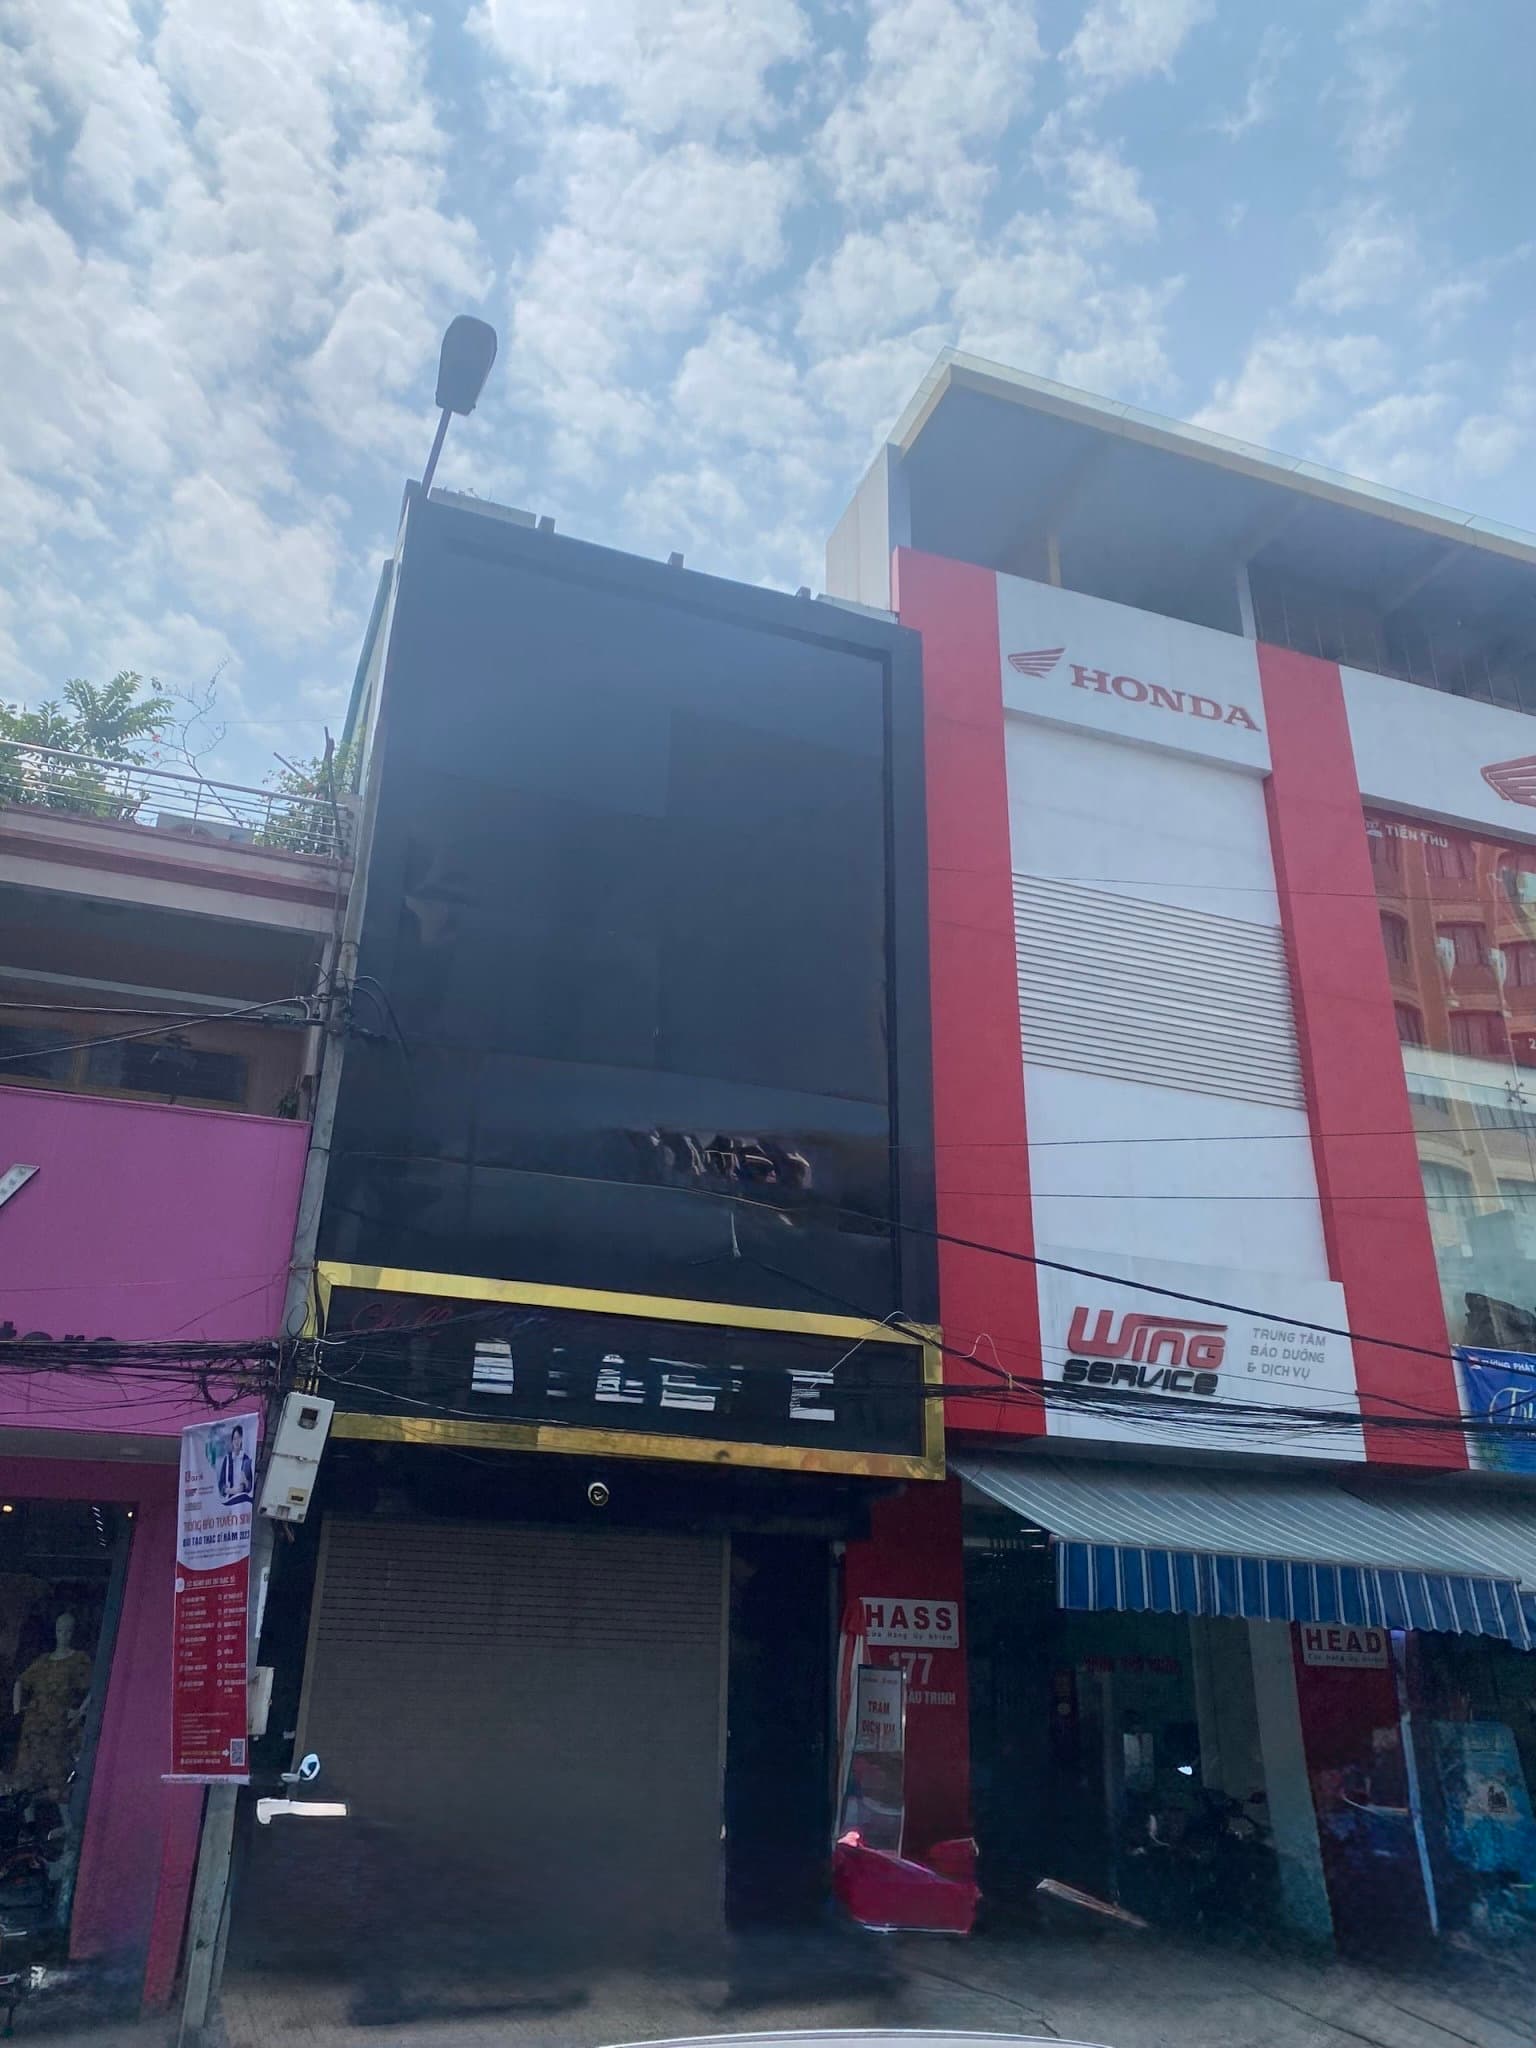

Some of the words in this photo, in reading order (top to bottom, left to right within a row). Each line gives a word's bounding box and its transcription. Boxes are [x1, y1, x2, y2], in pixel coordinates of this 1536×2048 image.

[1069, 664, 1262, 732] HONDA
[1067, 1306, 1228, 1369] WING
[1252, 1327, 1296, 1343] TRUNG
[1299, 1333, 1326, 1346] TÂM
[1062, 1359, 1219, 1395] SERVICE
[1247, 1362, 1257, 1373] &
[1261, 1363, 1290, 1377] DỊCH
[1293, 1367, 1311, 1380] VỤ
[866, 1604, 952, 1630] HASS
[1306, 1628, 1381, 1653] HEAD
[888, 1651, 934, 1685] 177
